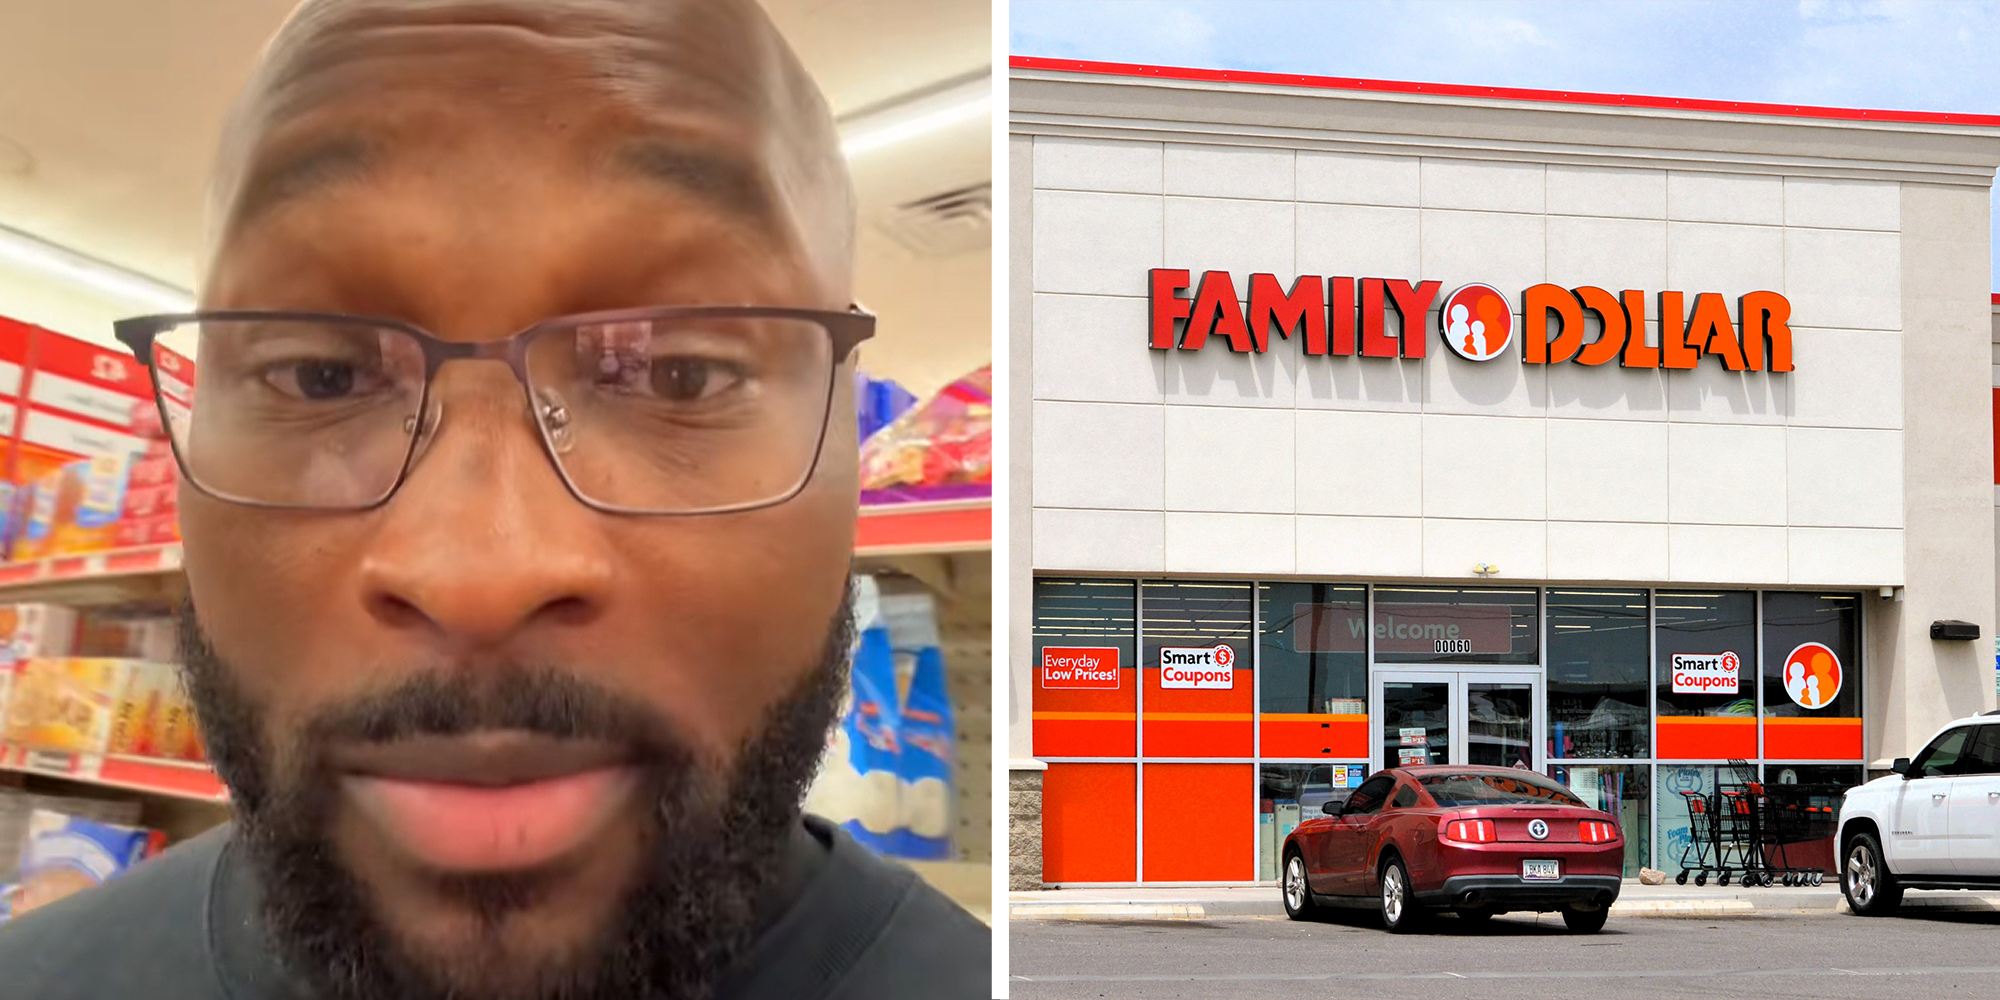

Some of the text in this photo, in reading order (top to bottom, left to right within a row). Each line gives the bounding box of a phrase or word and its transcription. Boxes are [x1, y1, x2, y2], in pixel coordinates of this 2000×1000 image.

[1148, 268, 1793, 372] FAMILY DOLLAR
[1347, 616, 1460, 639] Welcome
[1435, 640, 1470, 653] 00060
[1045, 654, 1100, 670] Everyday
[1163, 650, 1211, 665] Smart
[1674, 656, 1719, 670] Smart
[1045, 668, 1117, 681] Low Prices!
[1163, 667, 1231, 686] Coupons
[1674, 672, 1737, 691] Coupons
[1667, 826, 1689, 840] Foam
